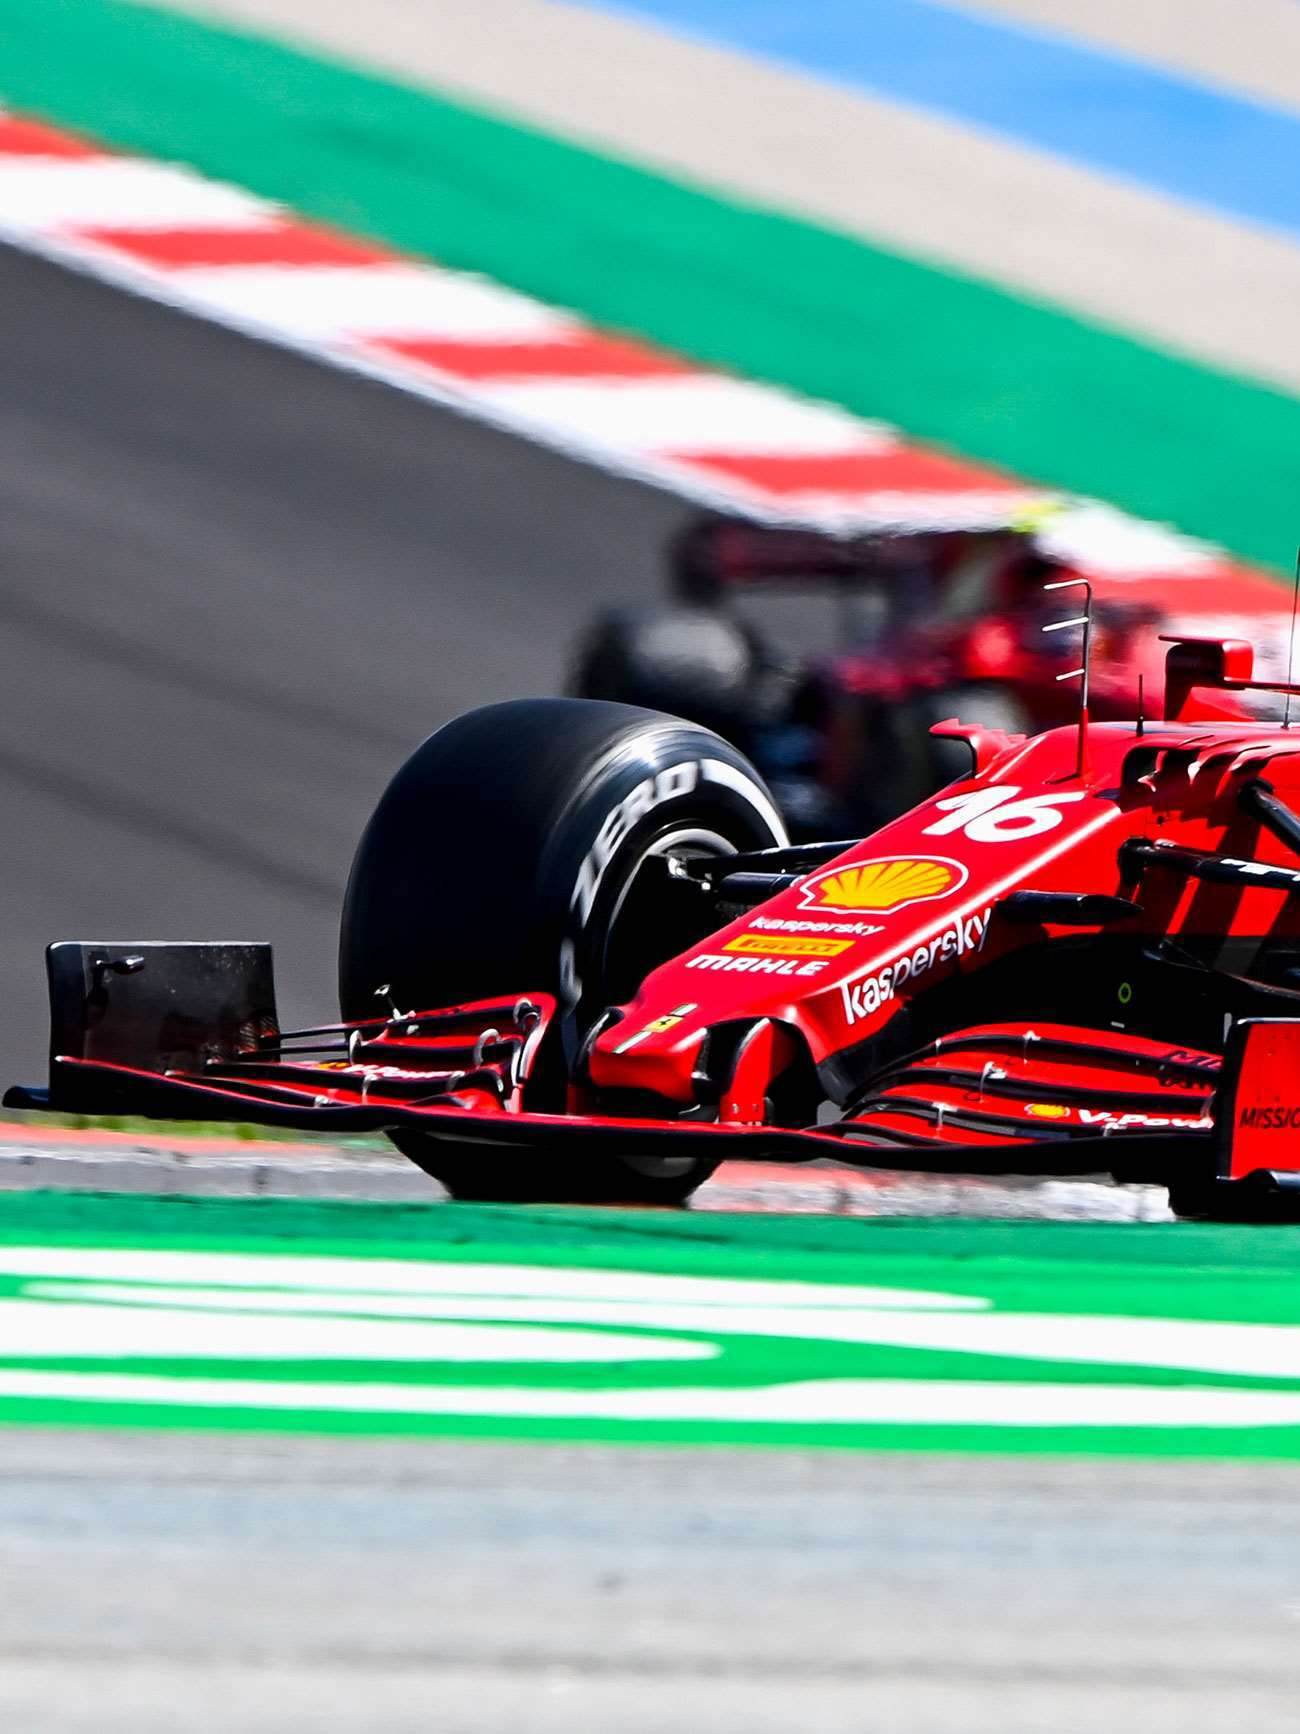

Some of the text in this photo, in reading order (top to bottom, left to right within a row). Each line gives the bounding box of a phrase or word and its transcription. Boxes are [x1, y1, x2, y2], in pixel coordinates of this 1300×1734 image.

[921, 785, 1087, 843] 16
[749, 916, 886, 937] kaspersky
[685, 954, 831, 977] MAHLE
[841, 907, 992, 1025] kaspersky
